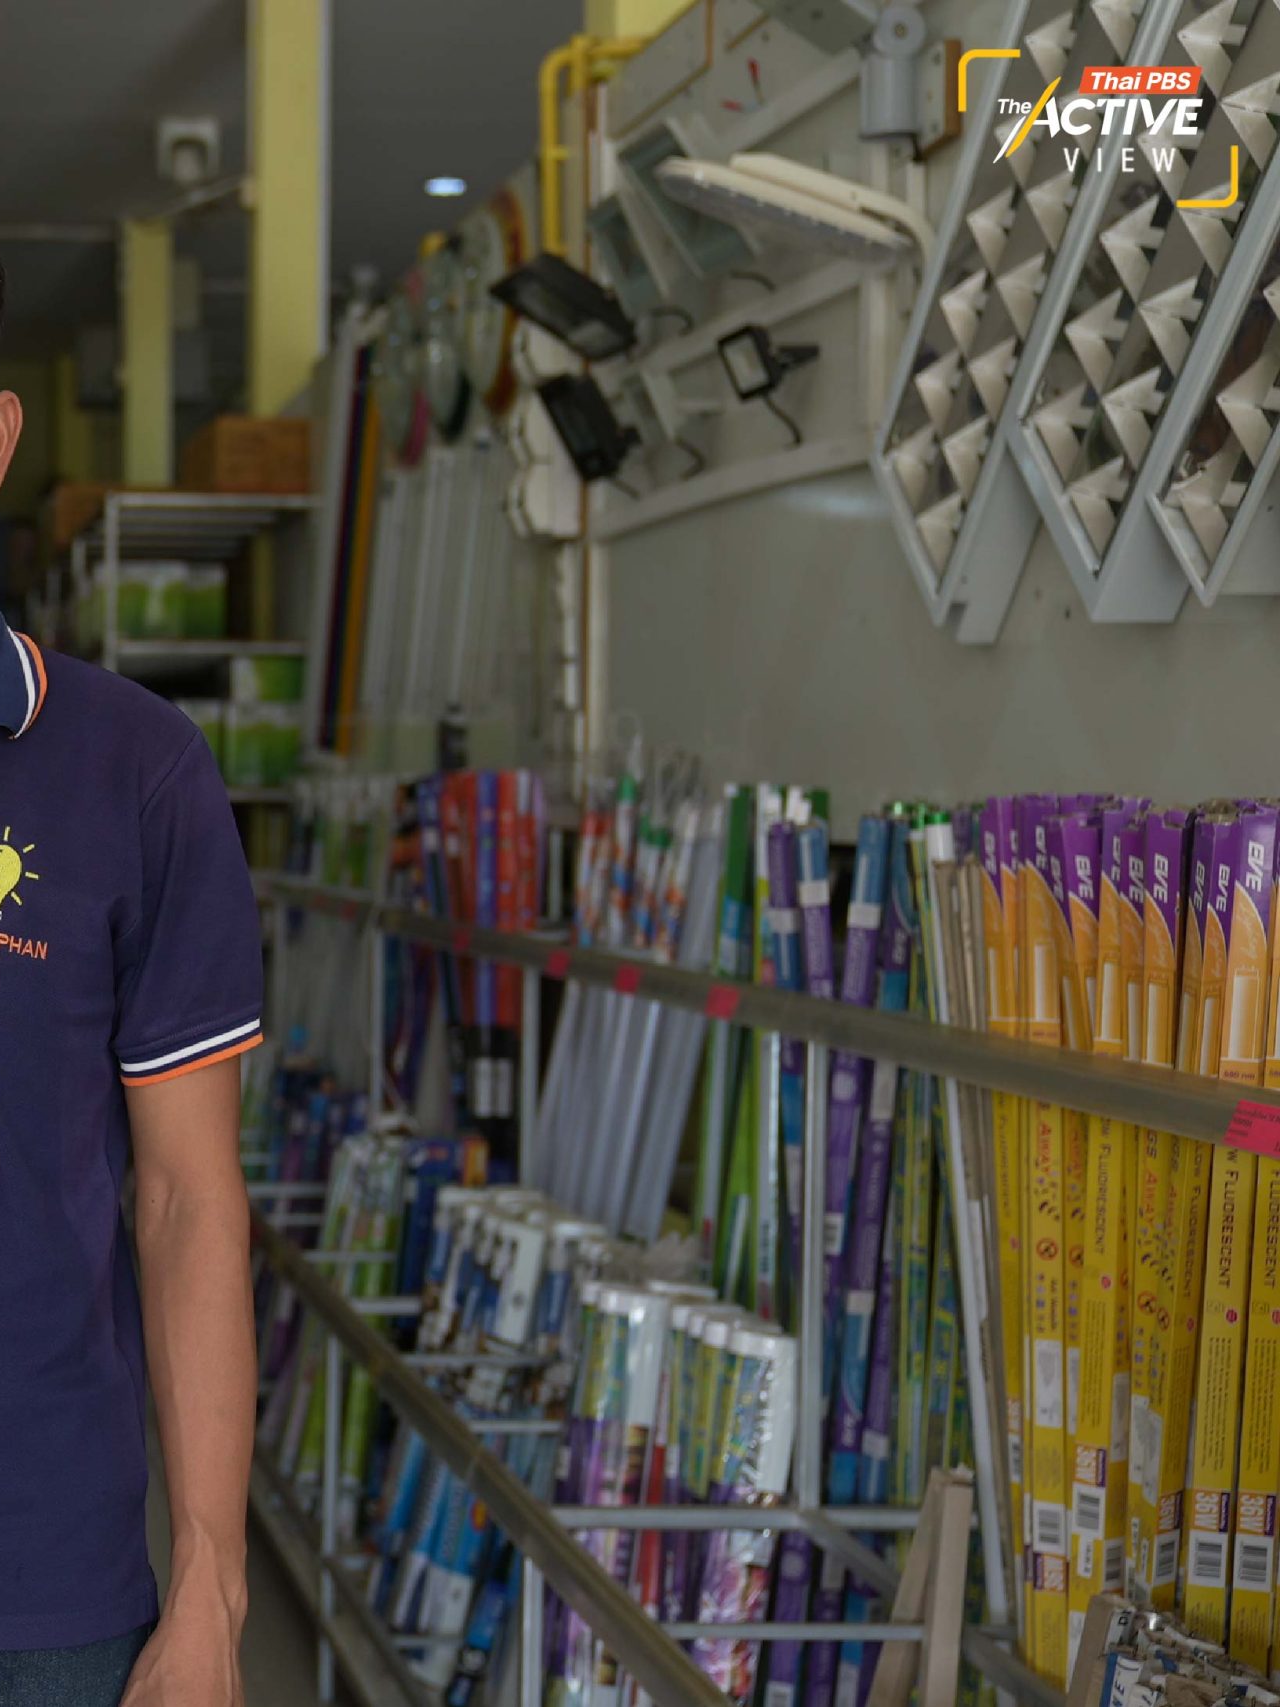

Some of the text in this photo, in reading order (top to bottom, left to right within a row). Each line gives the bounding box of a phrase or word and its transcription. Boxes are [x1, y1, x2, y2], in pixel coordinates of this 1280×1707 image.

[1128, 855, 1145, 905] EVE
[1153, 853, 1169, 904] EVE
[1193, 860, 1207, 912] EVE
[1217, 864, 1231, 913] EVE
[1245, 840, 1265, 893] EVE
[1096, 1143, 1111, 1255] FLUORESCENT
[1183, 1187, 1201, 1299] FLUORESCENT
[1218, 1170, 1239, 1289] FLUORESCENT
[1264, 1169, 1280, 1289] FLUORESCENT
[1077, 1445, 1096, 1483] 36W
[1160, 1496, 1175, 1532] 36W
[1196, 1492, 1218, 1530] 36W
[1241, 1493, 1263, 1533] 36W
